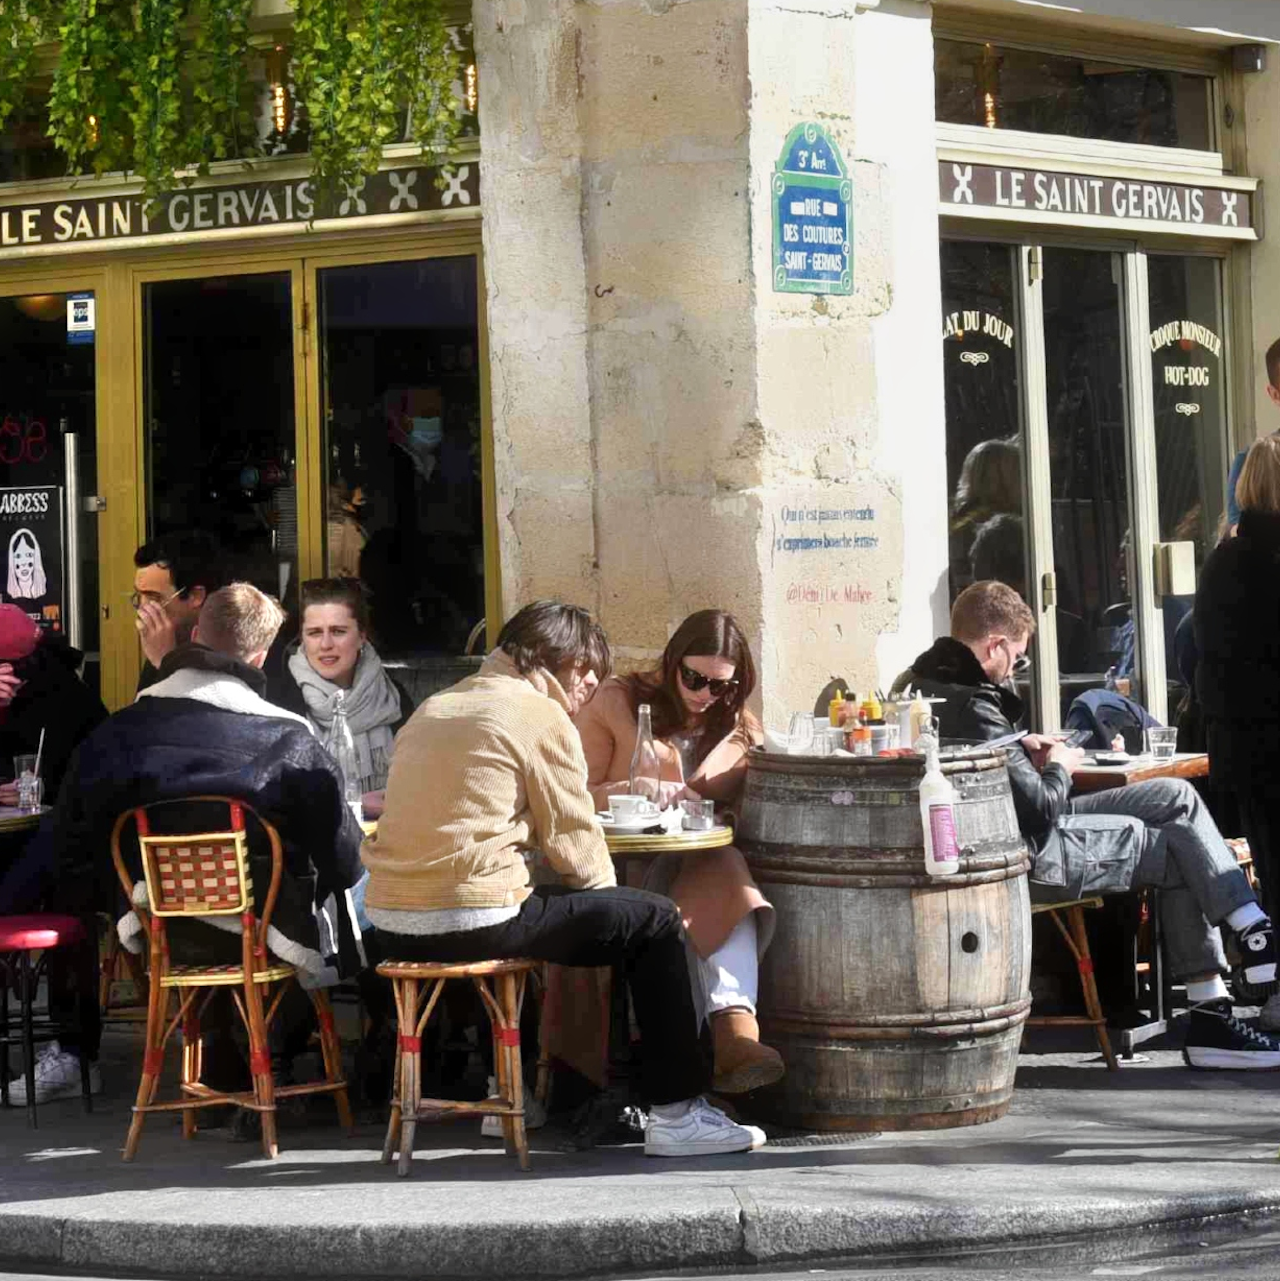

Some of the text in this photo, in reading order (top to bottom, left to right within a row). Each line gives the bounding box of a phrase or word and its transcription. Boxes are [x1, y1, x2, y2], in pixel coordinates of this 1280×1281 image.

[1, 180, 315, 246] LE SAINT GERVAIS
[805, 198, 821, 217] RUE
[995, 170, 1205, 223] LE SAINT GERVAIS
[783, 223, 844, 245] DES COUTURES
[963, 311, 980, 331] DU
[983, 313, 1013, 348] JOUR
[1150, 320, 1221, 358] CROQUE MONSIEUR
[1164, 366, 1209, 386] HOT-DOG
